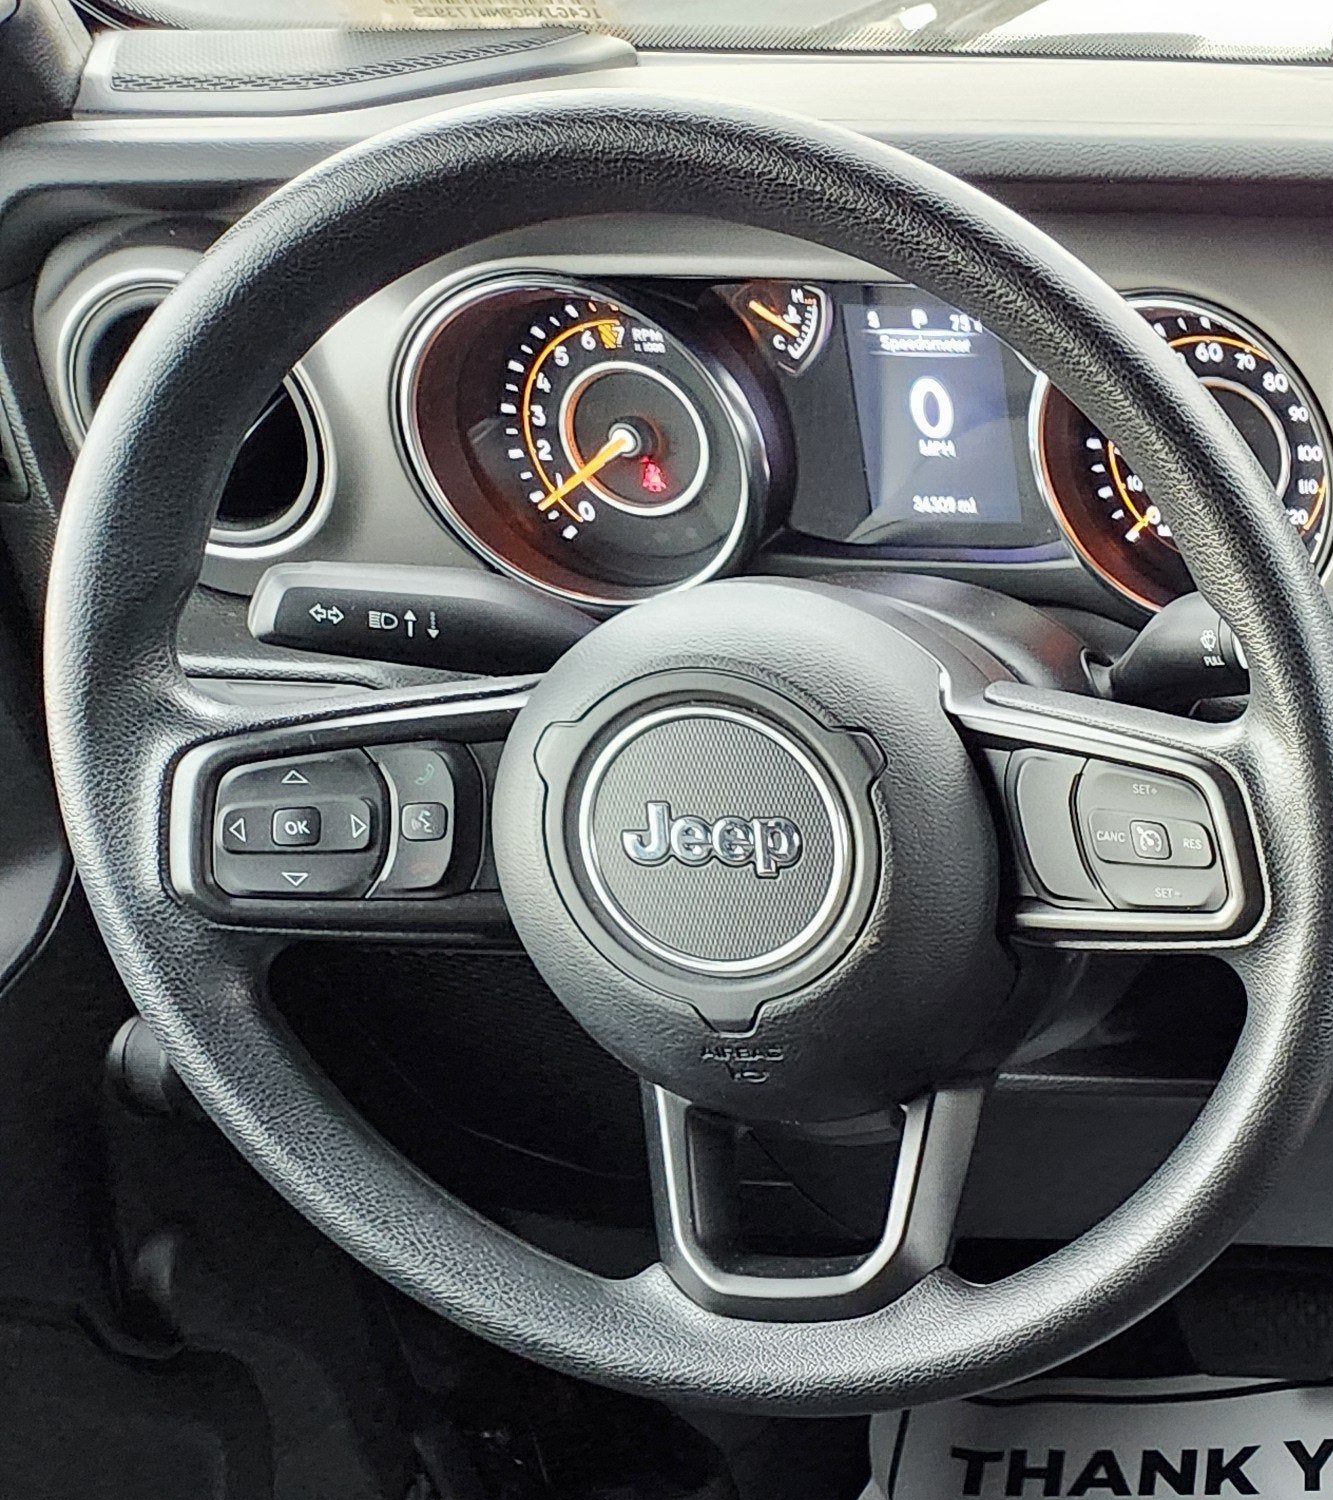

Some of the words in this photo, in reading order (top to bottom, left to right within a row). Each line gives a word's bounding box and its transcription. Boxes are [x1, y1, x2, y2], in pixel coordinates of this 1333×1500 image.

[581, 331, 596, 350] 6
[631, 327, 664, 342] RPM
[554, 346, 569, 366] 5
[1195, 343, 1223, 363] 60
[1235, 353, 1256, 371] 70
[536, 373, 551, 393] 4
[1262, 372, 1288, 393] 80
[531, 404, 546, 427] 3
[910, 377, 955, 439] 0
[1288, 404, 1308, 422] 90
[536, 440, 553, 461] 2
[1297, 444, 1323, 461] 100
[1298, 479, 1319, 494] 110
[578, 501, 595, 521] 0
[1287, 508, 1308, 525] 20
[284, 820, 311, 837] OK
[1096, 830, 1126, 843] CANC
[621, 801, 802, 879] Jeep
[1182, 837, 1202, 850] RES
[950, 1443, 1260, 1499] THANK
